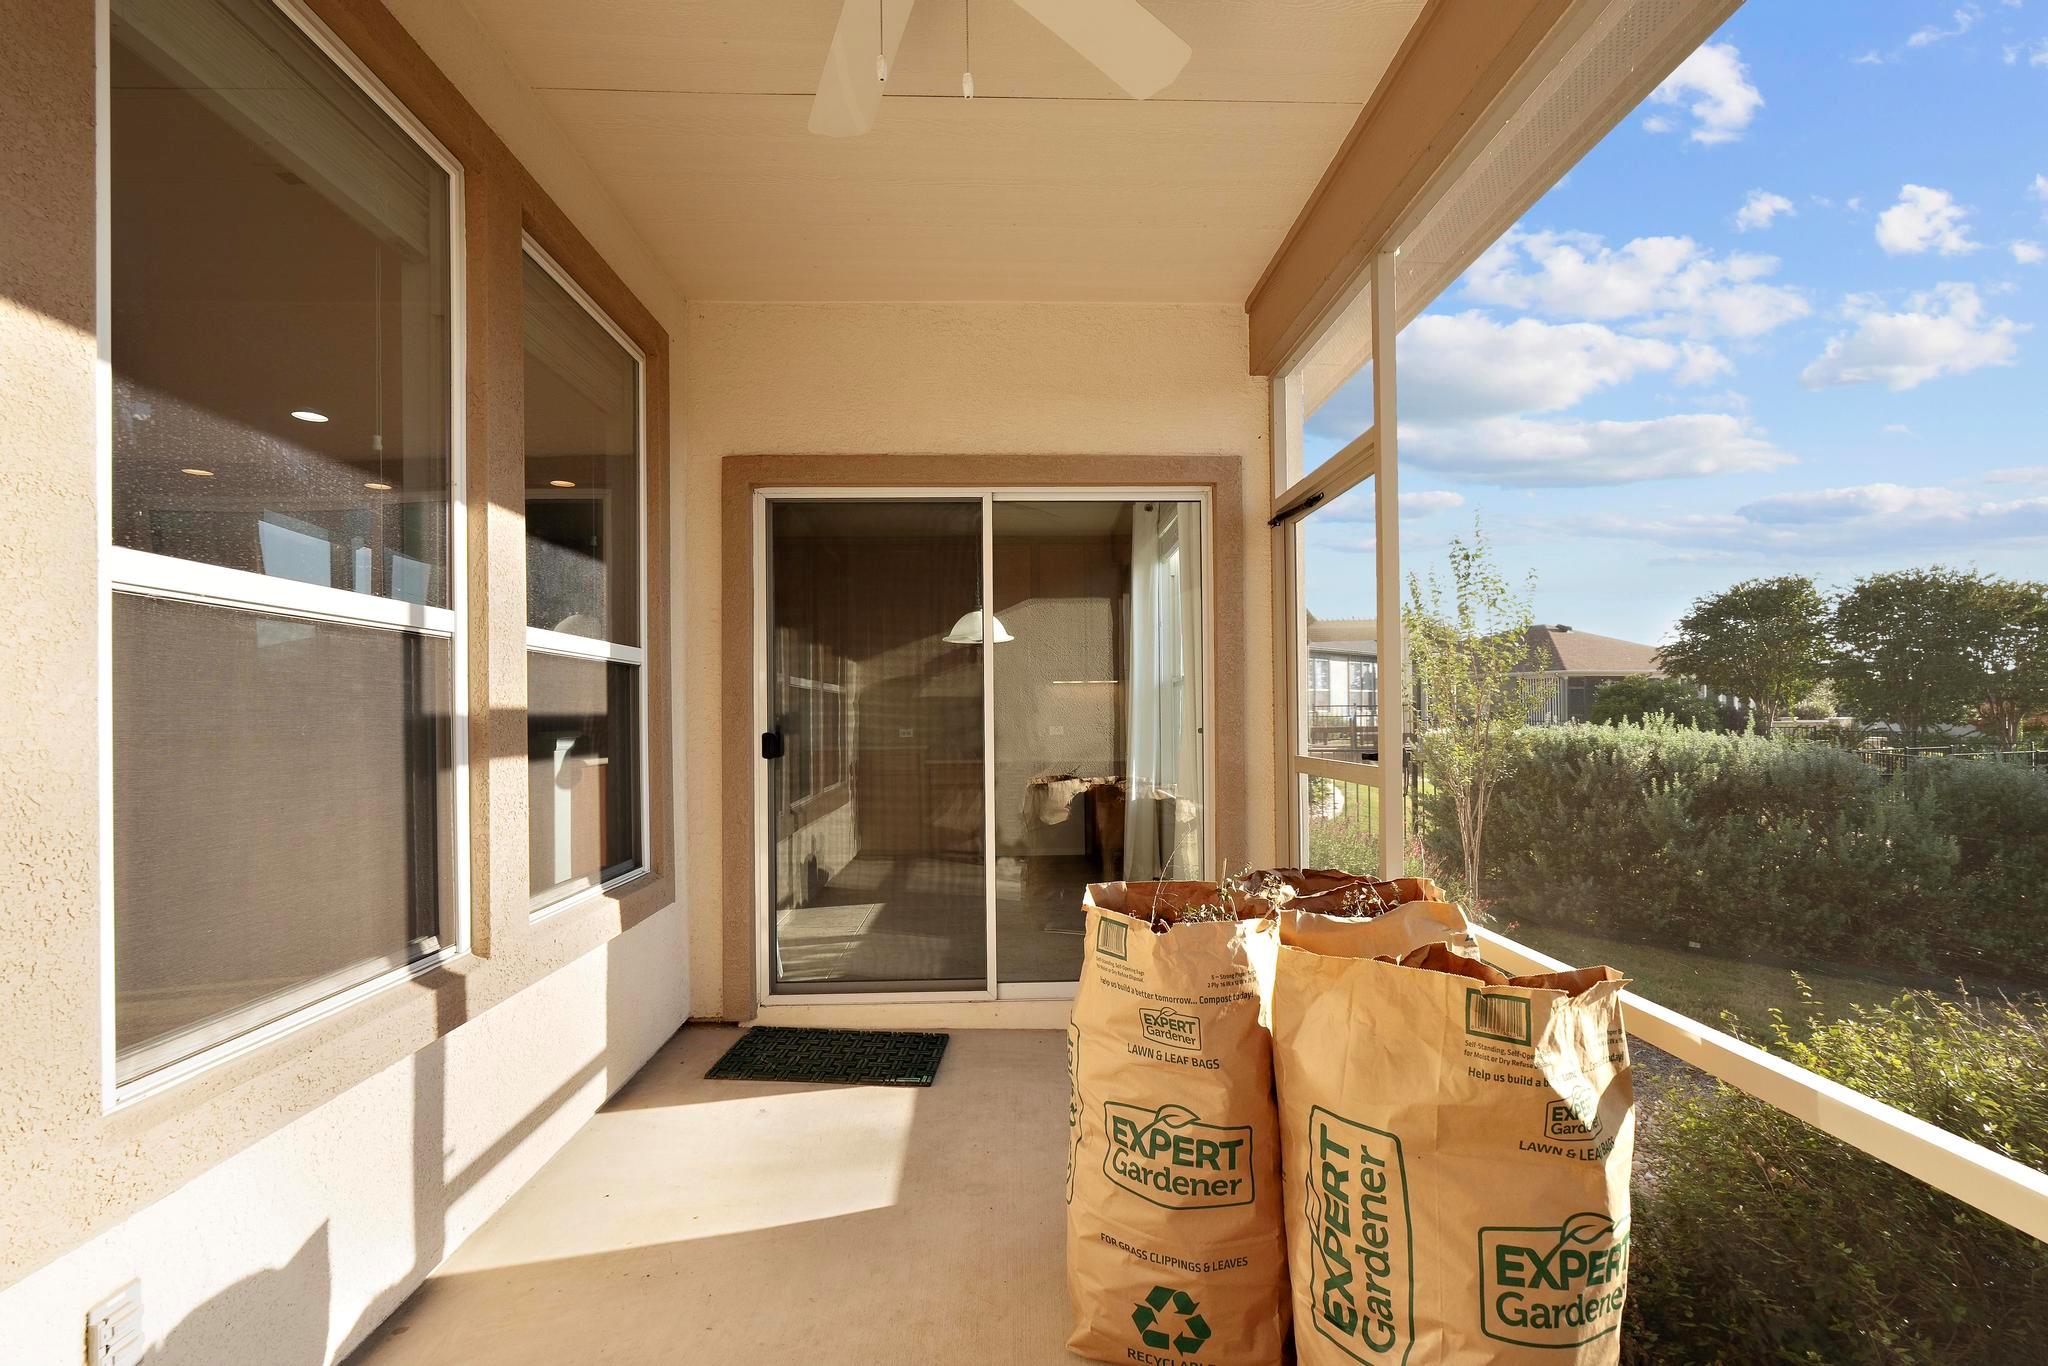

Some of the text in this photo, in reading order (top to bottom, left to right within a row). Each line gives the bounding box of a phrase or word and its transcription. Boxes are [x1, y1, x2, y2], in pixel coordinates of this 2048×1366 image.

[1111, 981, 1117, 989] us
[1117, 981, 1130, 993] build
[1135, 987, 1154, 1000] better
[1199, 994, 1232, 1005] Compost
[1232, 989, 1254, 1001] today!
[1143, 1013, 1196, 1035] EXPERT
[1146, 1025, 1197, 1046] Gardener
[1127, 1042, 1220, 1069] LAWN & LEAF BAGS
[1463, 1049, 1473, 1057] for
[1473, 1052, 1491, 1062] Moist
[1499, 1057, 1511, 1067] Dry
[1511, 1060, 1534, 1070] Refuse
[1464, 1040, 1507, 1057] Self-Standing,
[1468, 1066, 1491, 1080] Help
[1493, 1073, 1505, 1082] us
[1507, 1073, 1533, 1086] build
[1112, 1115, 1244, 1172] EXPERT
[1519, 1140, 1563, 1156] LAWN
[1566, 1148, 1577, 1159] &
[1112, 1147, 1243, 1197] Gardener
[1320, 1122, 1359, 1337] EXPERT
[1100, 1232, 1248, 1273] FOR GRASS CLIPPINGS & LEAVES
[1355, 1143, 1396, 1353] Gardener
[1495, 1283, 1626, 1329] Gardene
